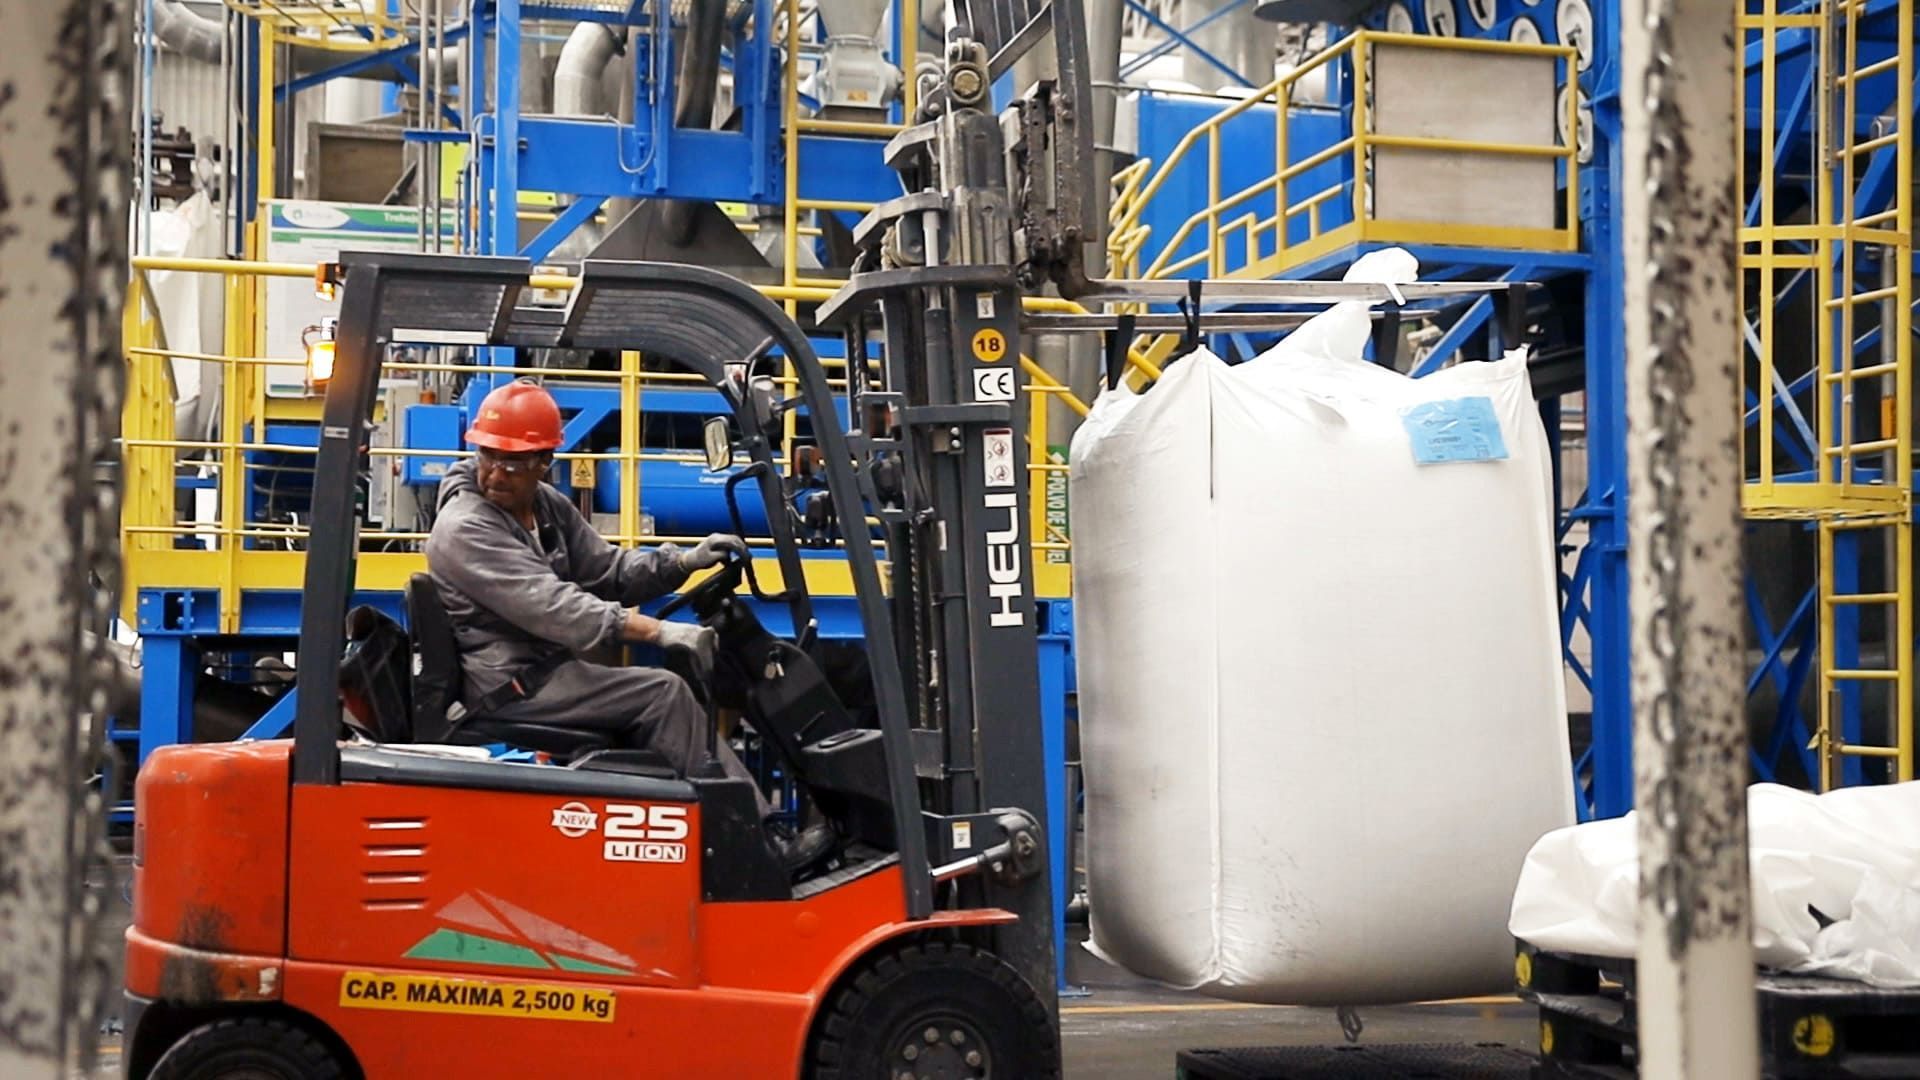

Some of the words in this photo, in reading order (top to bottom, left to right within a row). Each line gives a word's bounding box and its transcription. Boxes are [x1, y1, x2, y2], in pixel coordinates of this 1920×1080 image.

[975, 337, 1001, 352] 18
[979, 372, 1012, 396] CE
[1047, 477, 1067, 509] POLVO
[1047, 511, 1067, 525] DE
[984, 493, 1025, 627] HELI
[559, 813, 592, 826] NEW
[604, 804, 689, 840] 25
[346, 979, 398, 1001] CAP.
[406, 980, 504, 1007] MÁXIMA
[512, 990, 575, 1012] 2,500
[582, 994, 610, 1017] kg
